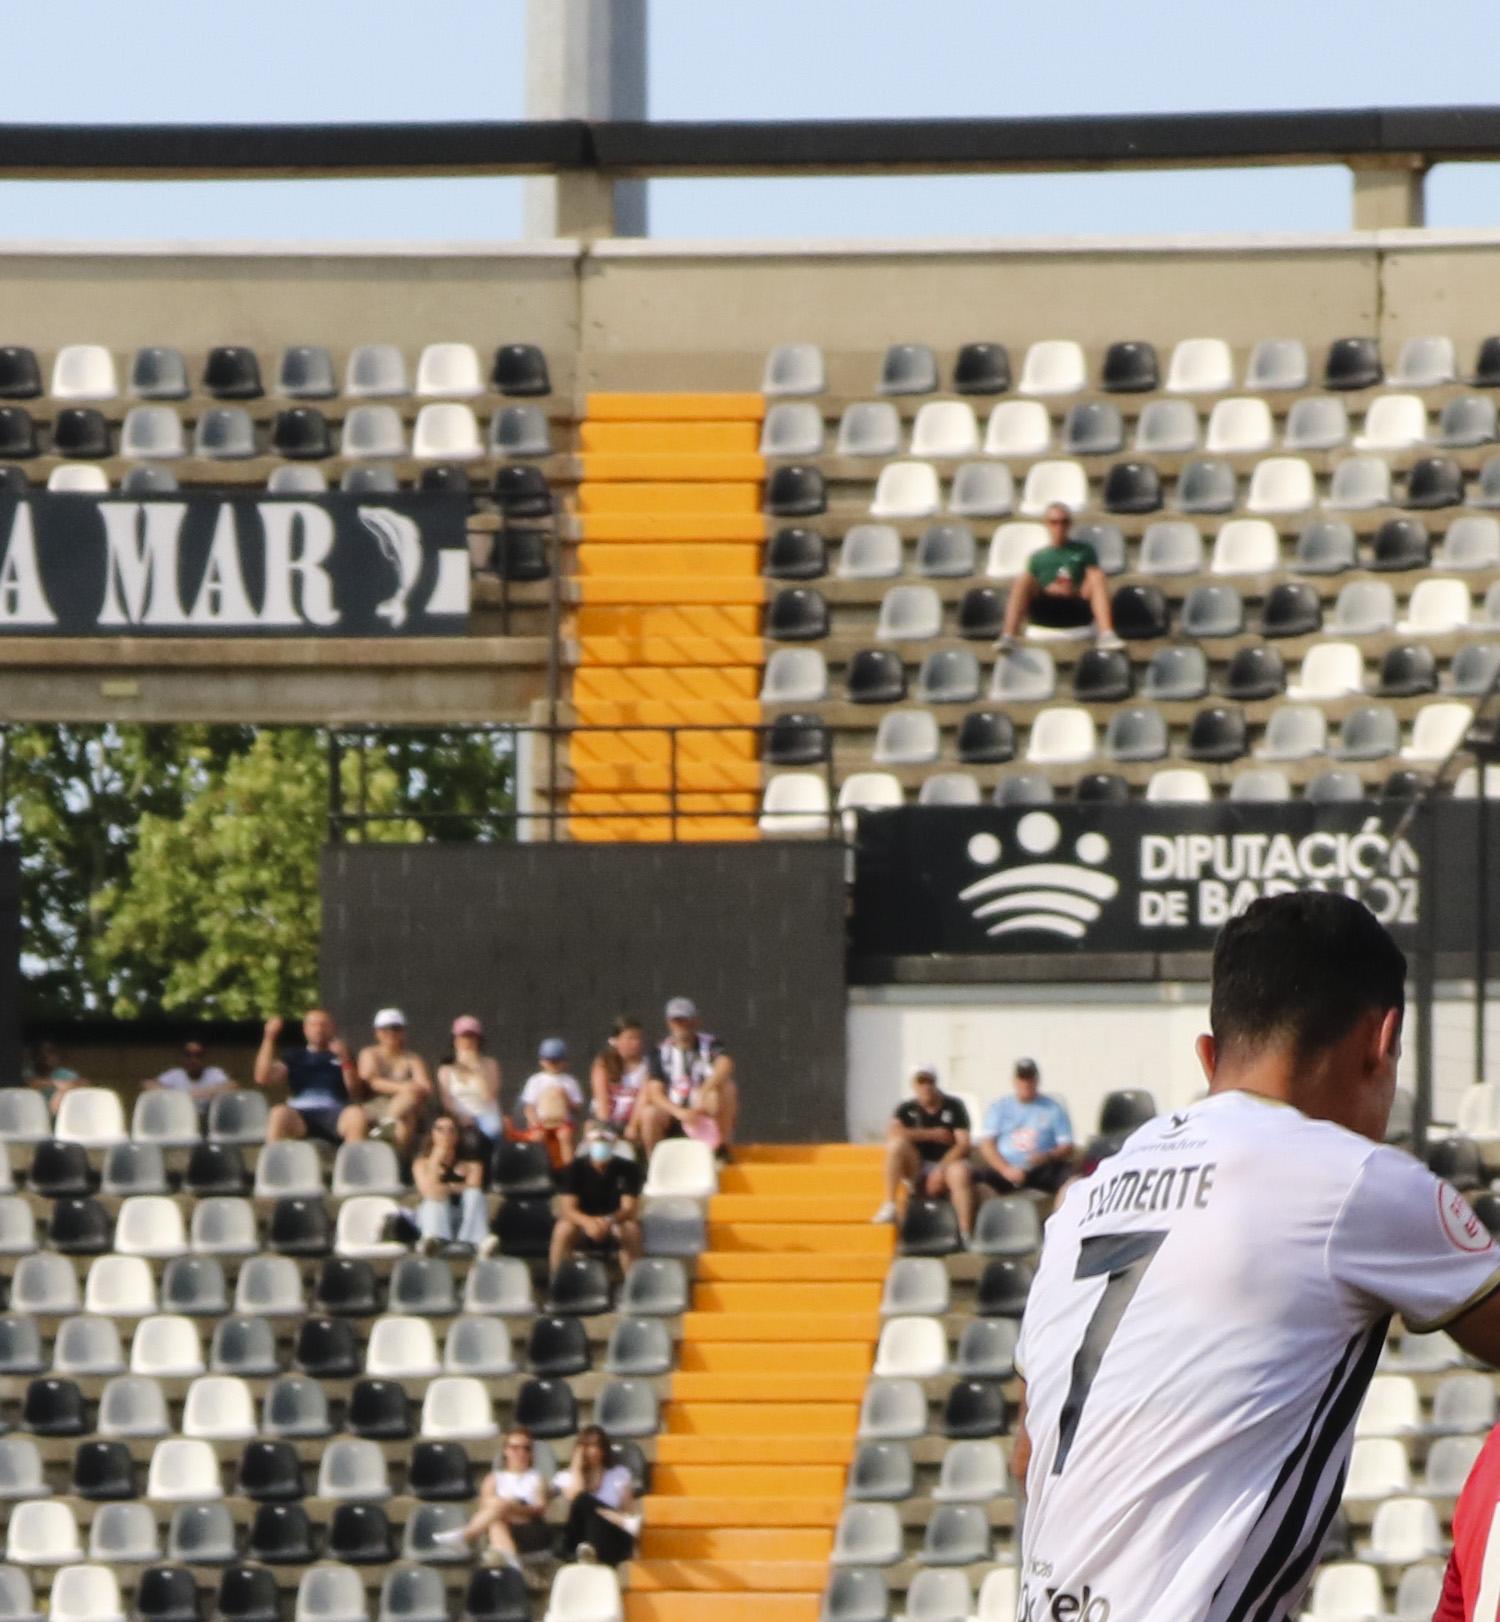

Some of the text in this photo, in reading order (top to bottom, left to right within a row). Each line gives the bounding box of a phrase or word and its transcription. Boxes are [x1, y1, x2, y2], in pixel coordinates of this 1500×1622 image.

[98, 500, 341, 628] MAR
[1139, 816, 1420, 881] DIPUTACIÓN
[1138, 890, 1189, 927] DE
[1052, 1229, 1170, 1476] 7
